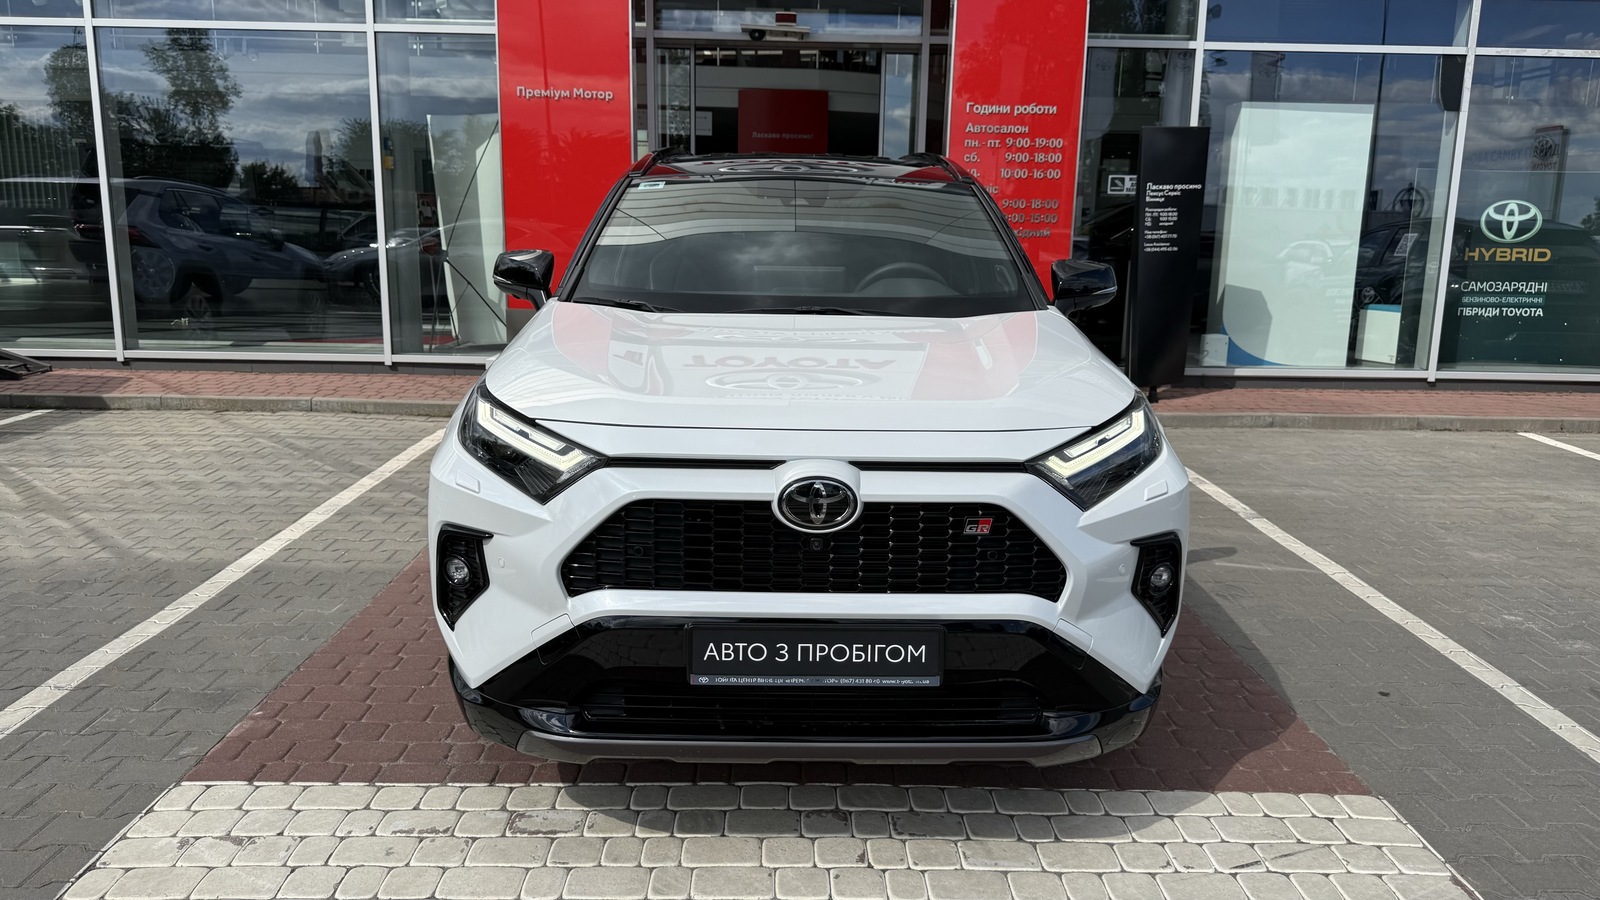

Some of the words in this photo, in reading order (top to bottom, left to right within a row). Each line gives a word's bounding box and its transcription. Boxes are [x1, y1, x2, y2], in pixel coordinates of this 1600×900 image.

[516, 86, 570, 100] Преміум
[573, 88, 613, 101] Мотор
[966, 102, 1011, 115] Години
[1014, 103, 1057, 116] роботи
[965, 122, 1029, 133] Автосалон
[1005, 138, 1063, 149] 9:00-19:00
[964, 152, 980, 162] сб.
[1005, 152, 1062, 163] 9:00-18:00
[967, 168, 980, 177] д.
[1001, 168, 1061, 179] 10:00-16:00
[1005, 213, 1058, 223] :00-15:00
[1464, 247, 1552, 262] HYBRID
[1460, 281, 1548, 294] САМОЗАРЯДНІ
[1457, 307, 1500, 318] ГІБРИДИ
[1502, 307, 1544, 317] TOYOTA
[703, 642, 768, 662] АВТО
[775, 643, 789, 662] З
[797, 643, 926, 663] ПРОБІГОМ
